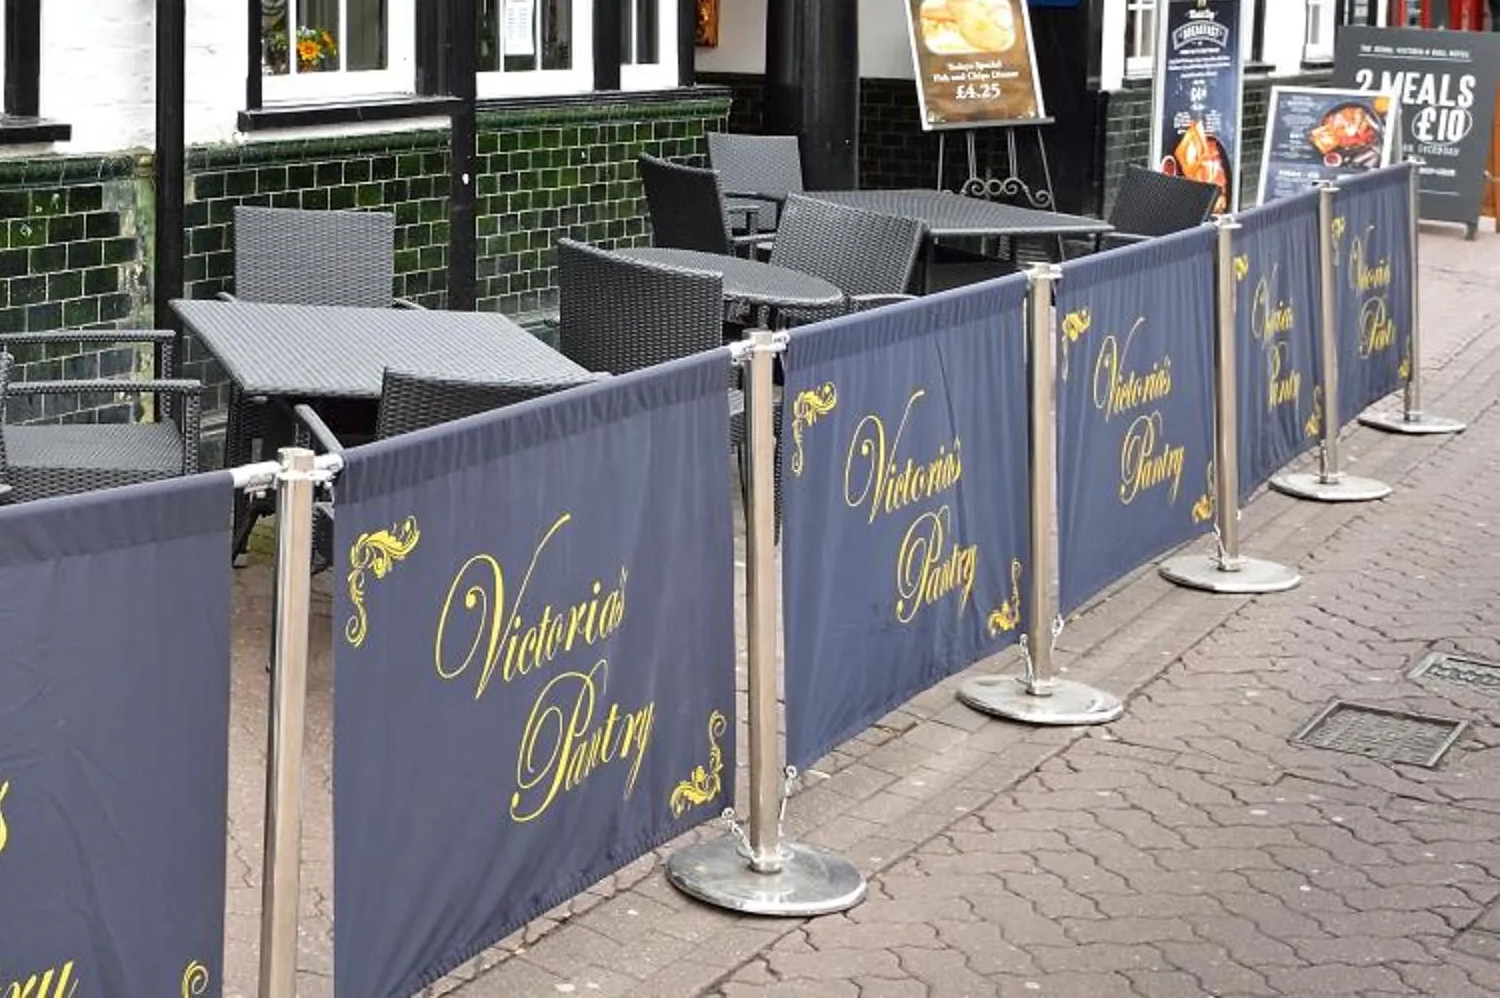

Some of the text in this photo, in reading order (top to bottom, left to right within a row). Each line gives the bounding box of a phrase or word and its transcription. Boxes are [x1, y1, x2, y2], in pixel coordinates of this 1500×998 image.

[1381, 70, 1476, 109] MEALS
[1417, 107, 1466, 141] £10
[435, 513, 629, 700] Victoria's
